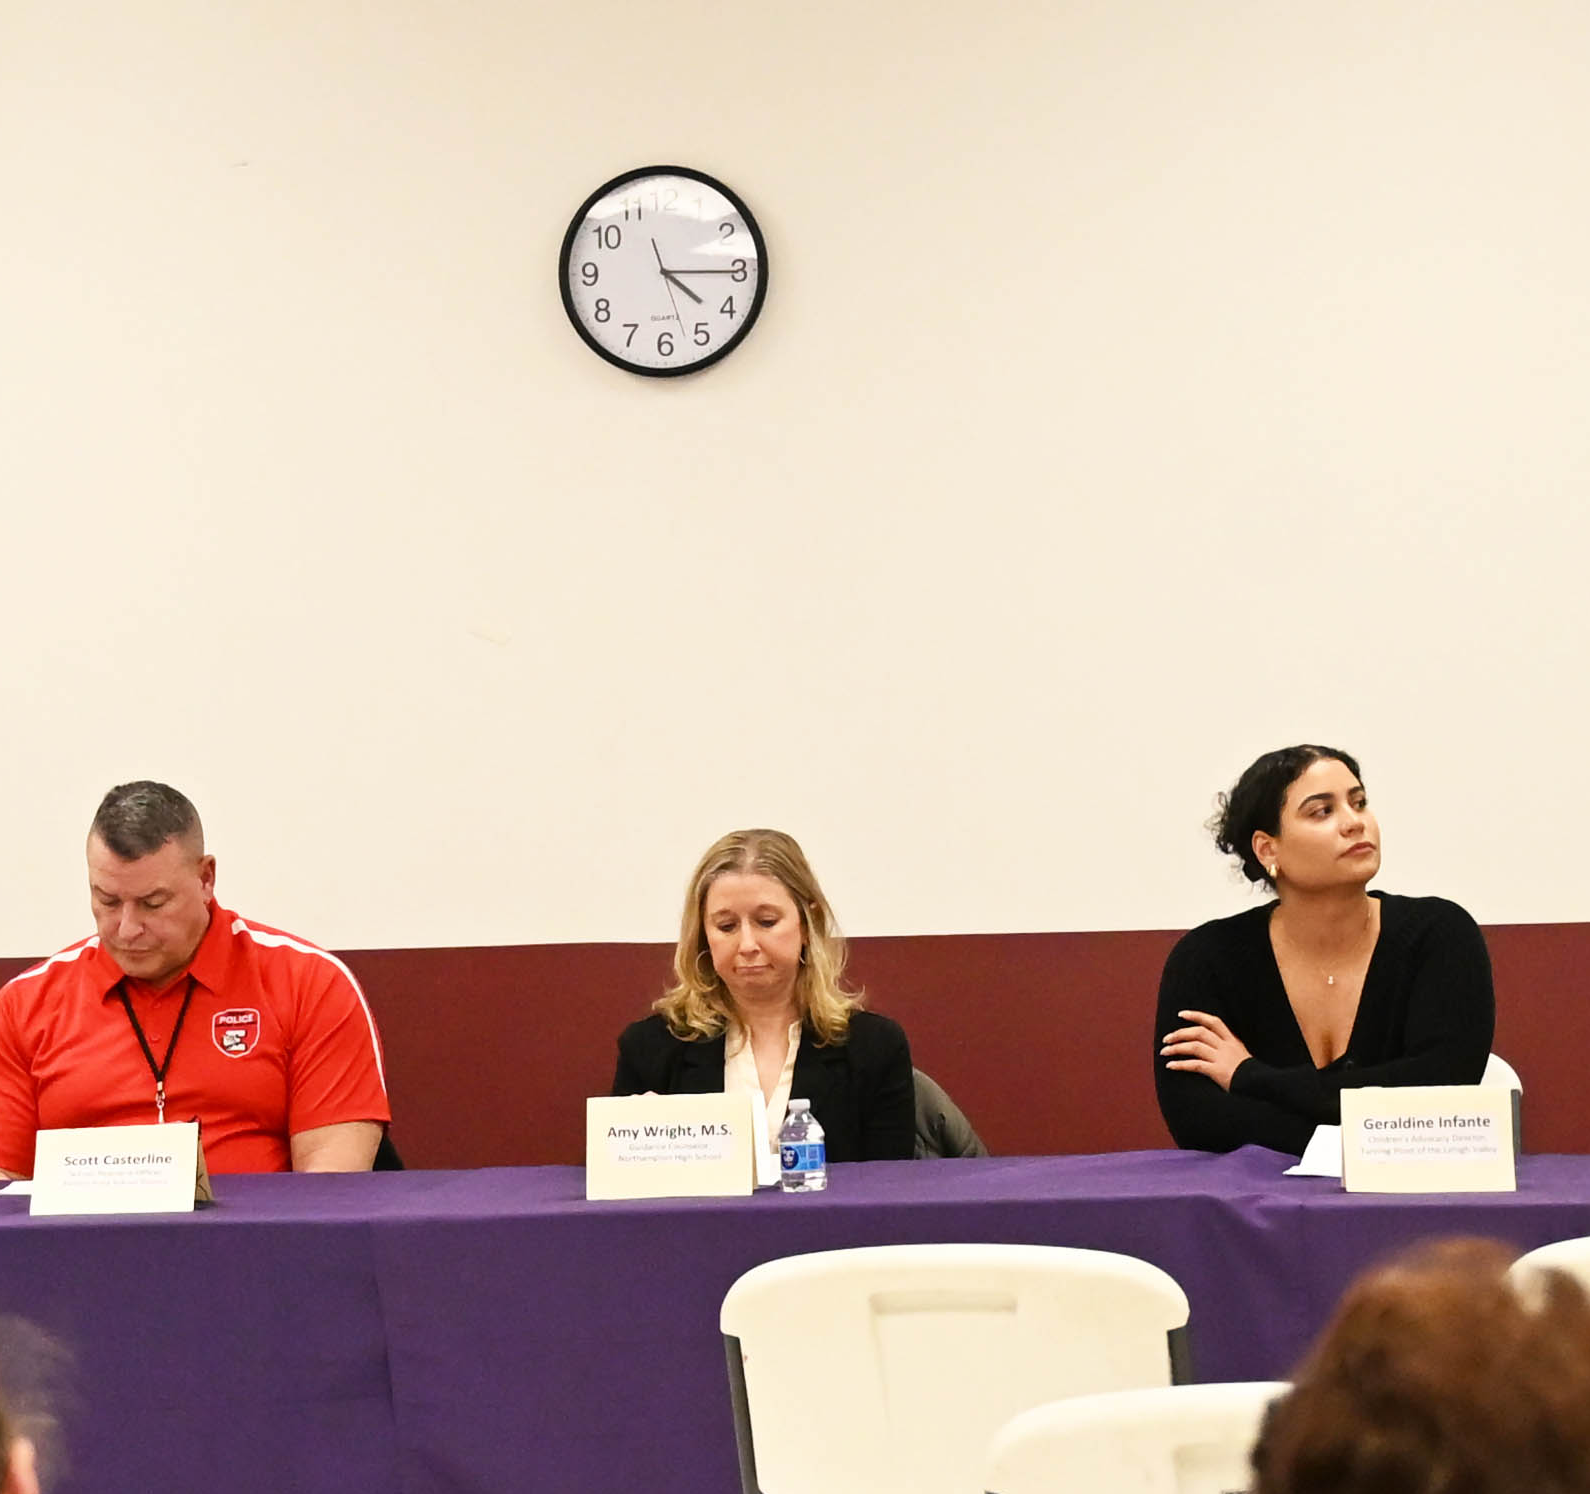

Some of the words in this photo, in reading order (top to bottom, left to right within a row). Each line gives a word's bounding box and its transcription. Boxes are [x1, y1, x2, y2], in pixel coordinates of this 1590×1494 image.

[621, 197, 642, 220] 11
[649, 188, 679, 212] 12
[592, 225, 621, 249] 10
[719, 222, 735, 246] 2
[581, 262, 599, 286] 9
[730, 259, 747, 282] 3
[594, 299, 610, 323] 8
[719, 296, 736, 319] 4
[622, 324, 639, 347] 7
[657, 332, 674, 356] 6
[693, 323, 710, 346] 5
[219, 1013, 254, 1024] POLICE
[607, 1126, 640, 1140] Amy
[644, 1124, 697, 1139] Wright,
[701, 1124, 732, 1136] M.S.
[1364, 1117, 1434, 1130] Geraldine
[1439, 1115, 1491, 1128] Infante
[64, 1155, 99, 1167] Scott
[104, 1153, 172, 1166] Casterline
